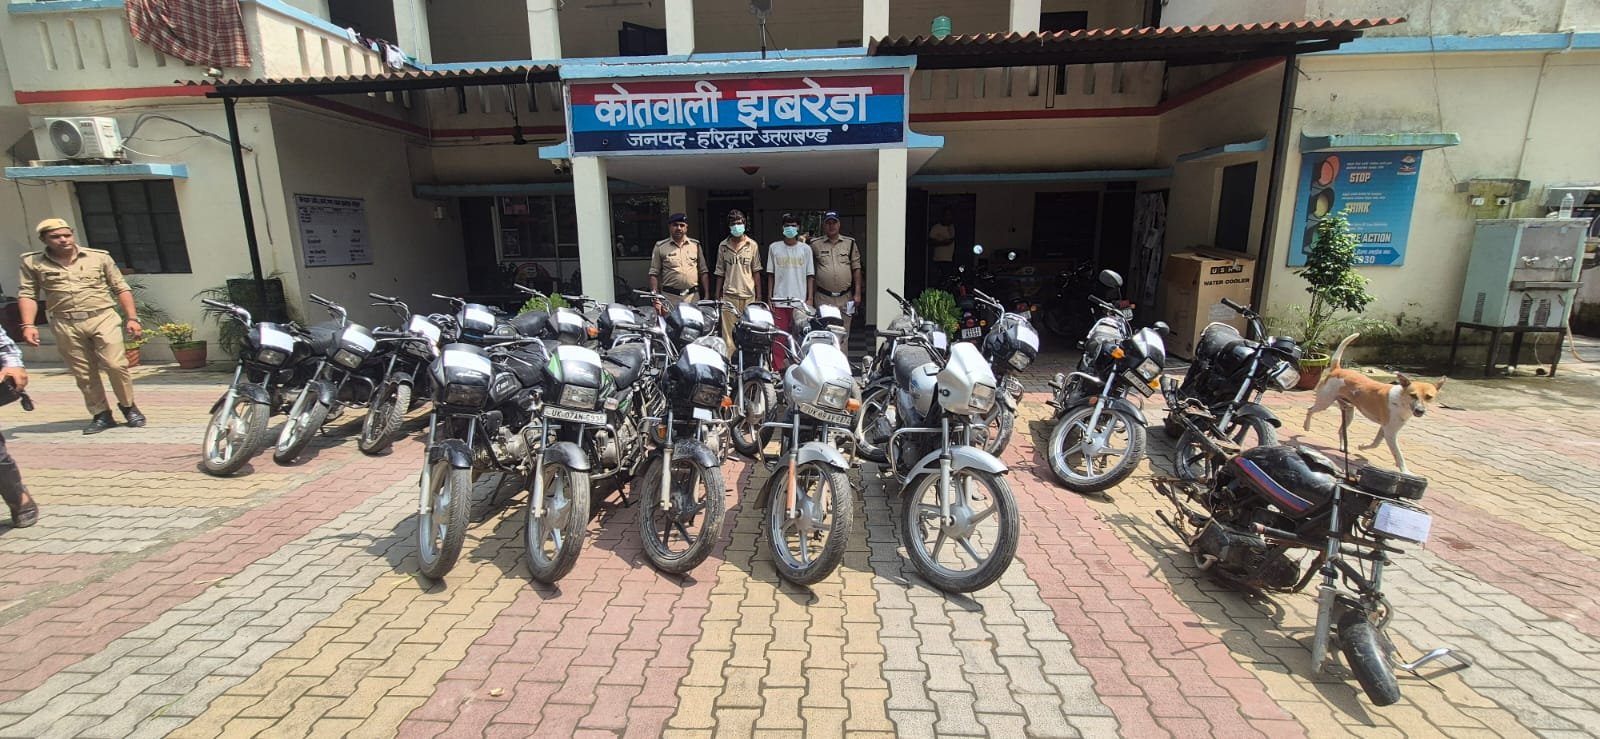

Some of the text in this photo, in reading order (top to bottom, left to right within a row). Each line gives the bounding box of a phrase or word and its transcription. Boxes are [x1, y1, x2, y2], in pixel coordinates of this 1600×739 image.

[594, 77, 873, 132] कोतवाली झबरेड़ा
[1349, 172, 1371, 183] STOP
[1363, 232, 1392, 243] ACTION
